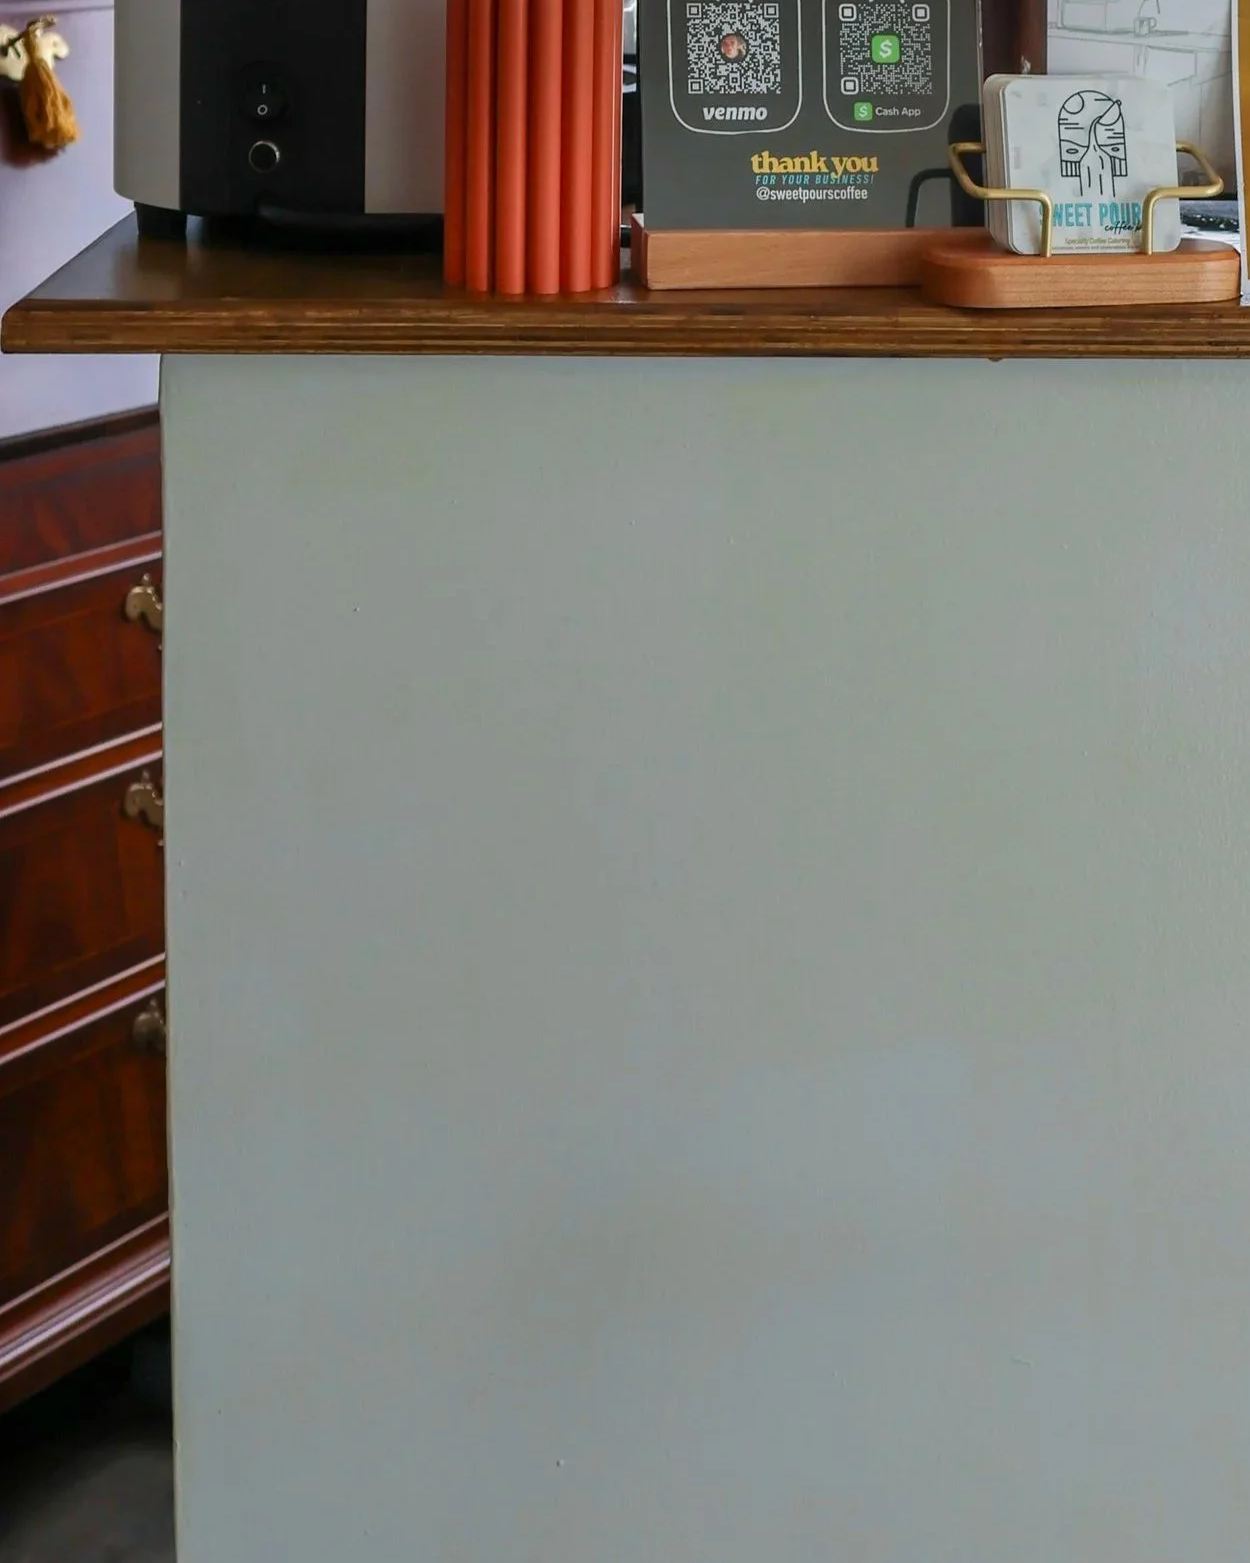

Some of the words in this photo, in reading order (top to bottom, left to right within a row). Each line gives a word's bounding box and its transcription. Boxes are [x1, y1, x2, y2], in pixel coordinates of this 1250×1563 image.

[703, 107, 767, 120] venmo
[875, 107, 899, 116] Cash
[901, 107, 921, 117] App
[751, 150, 828, 173] thank
[831, 155, 879, 179] you
[755, 175, 776, 185] FOR
[782, 175, 810, 185] YOUR
[815, 174, 874, 185] BUSINESS!
[756, 186, 868, 203] @sweetpourscoffee
[1039, 202, 1092, 227] WEET
[1098, 202, 1141, 226] POUR
[1104, 221, 1133, 235] coffee
